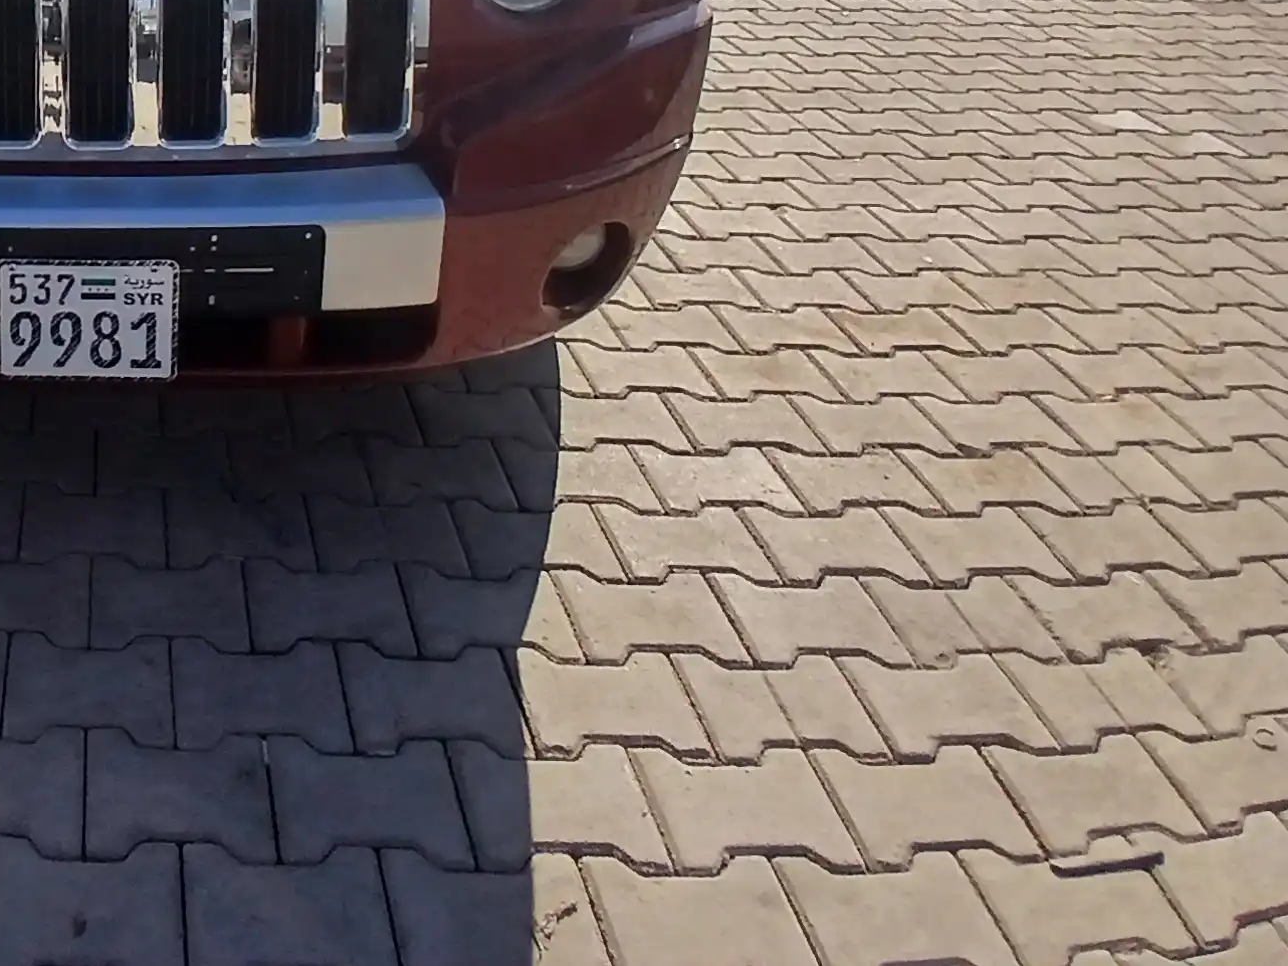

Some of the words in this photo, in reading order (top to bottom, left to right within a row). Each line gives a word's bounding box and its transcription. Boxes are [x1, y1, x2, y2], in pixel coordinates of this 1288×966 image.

[9, 273, 75, 305] 537
[123, 274, 165, 289] سورية
[123, 292, 164, 305] SYR
[9, 311, 162, 369] 9981
